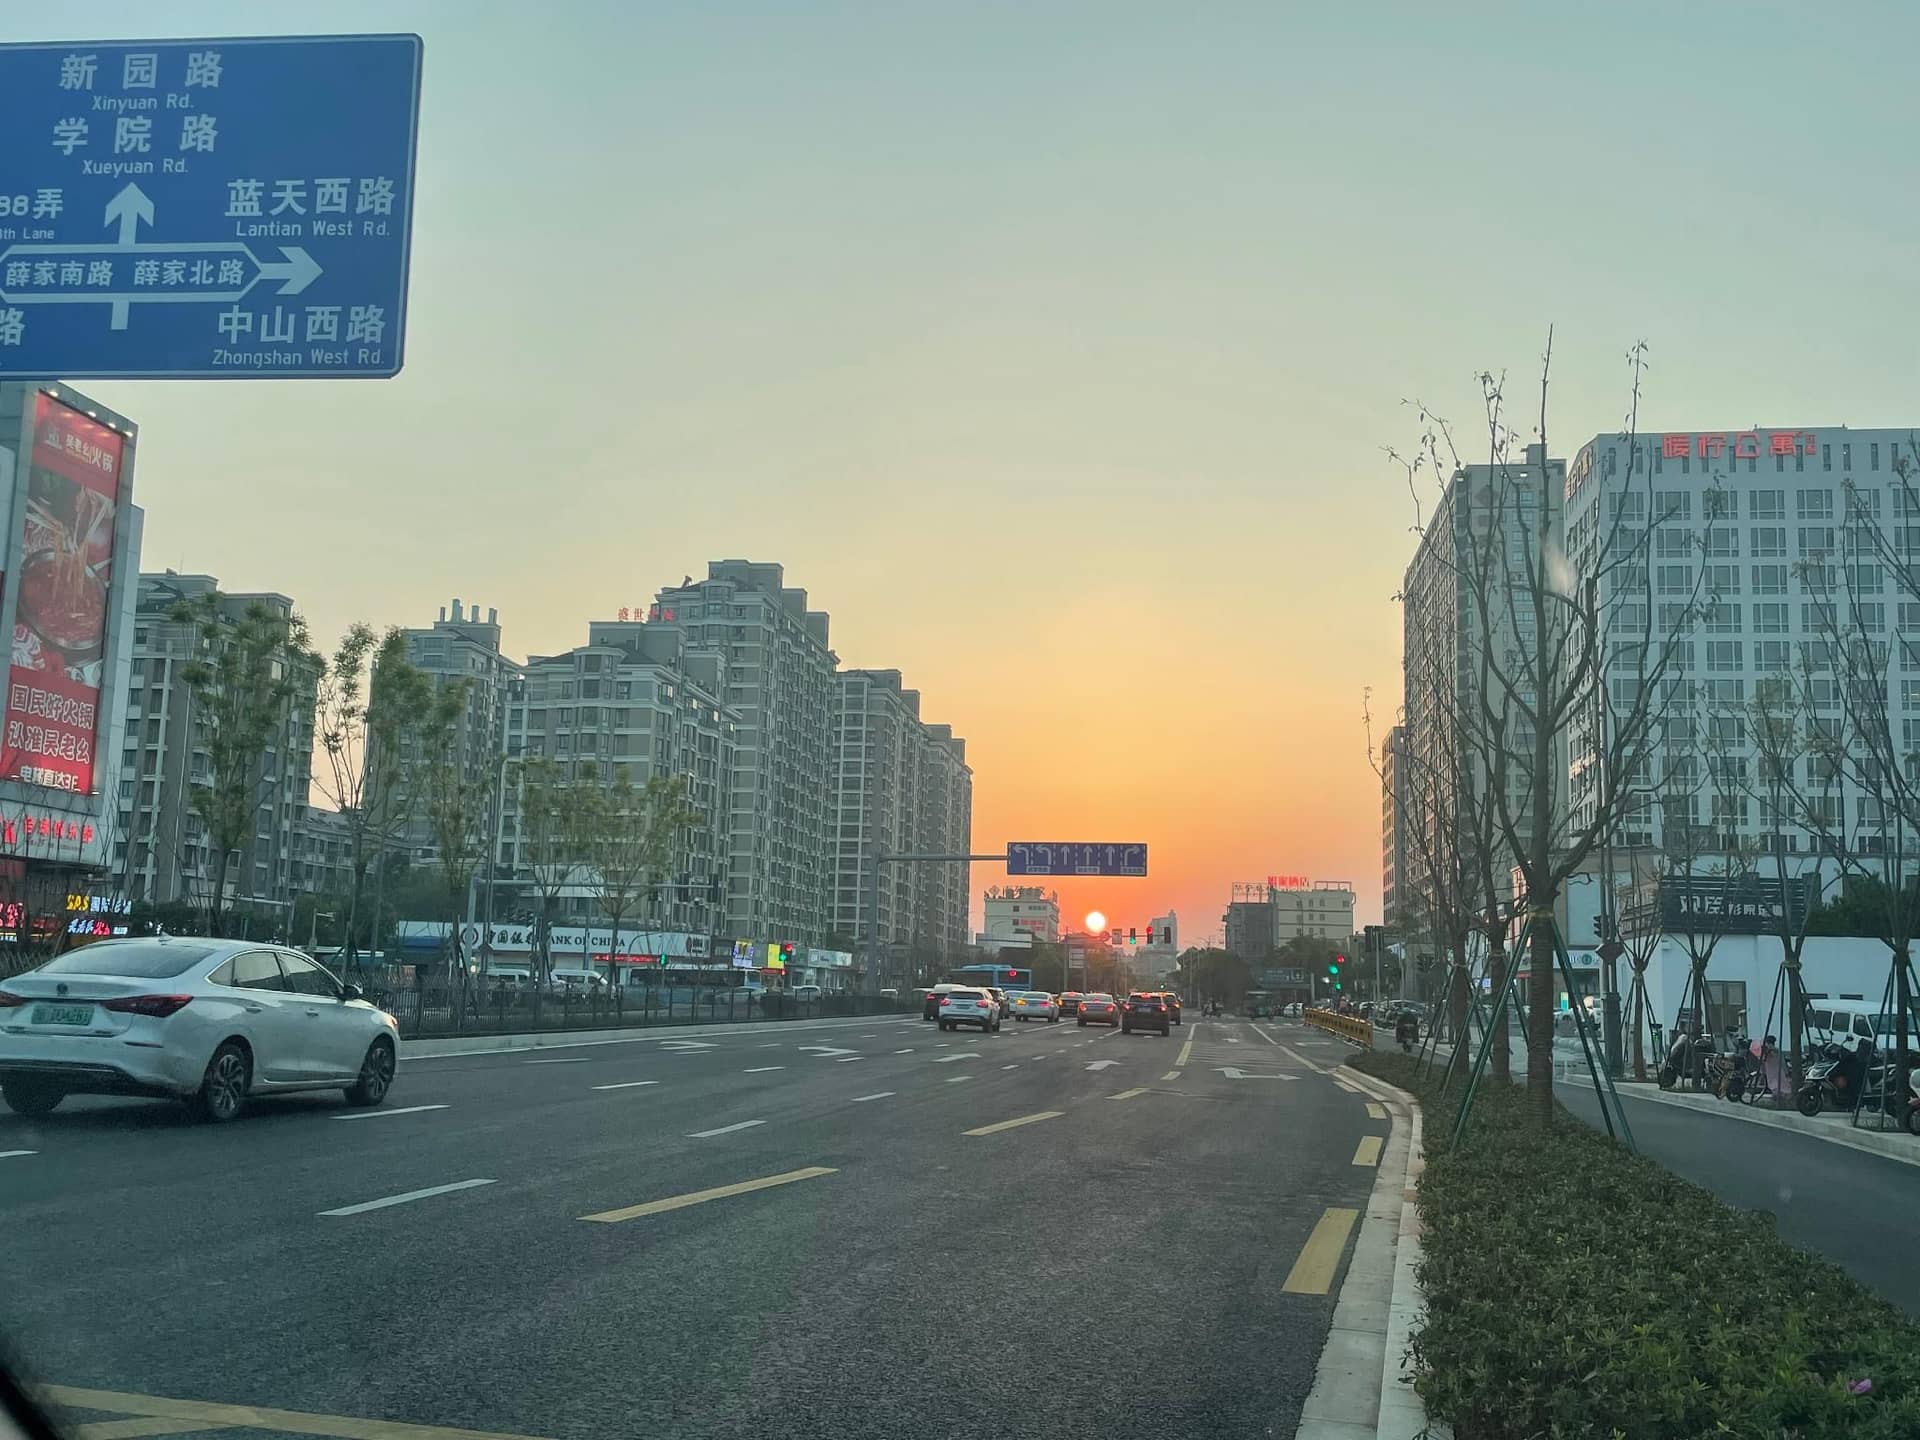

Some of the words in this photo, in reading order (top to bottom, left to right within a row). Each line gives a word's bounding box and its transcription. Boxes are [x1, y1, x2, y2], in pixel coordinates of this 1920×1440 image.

[59, 51, 224, 90] 新园路
[92, 94, 158, 113] Xinyuan
[166, 93, 195, 109] Rd.
[52, 114, 219, 156] 学院路
[82, 159, 154, 178] Xueyuan
[162, 158, 188, 174] Rd.
[224, 176, 396, 217] 蓝天西路
[23, 227, 55, 240] Lane
[236, 221, 302, 237] Lantian
[312, 221, 353, 237] West
[363, 221, 391, 237] Rd.
[5, 259, 114, 287] 薛家南路
[133, 258, 245, 287] 薛家北路
[217, 304, 386, 345] 中山西路
[212, 349, 302, 368] Zhongshan
[310, 349, 350, 365] West
[357, 349, 384, 365] Rd.
[10, 683, 95, 730] 国民好火锅
[591, 936, 625, 947] CHIA
